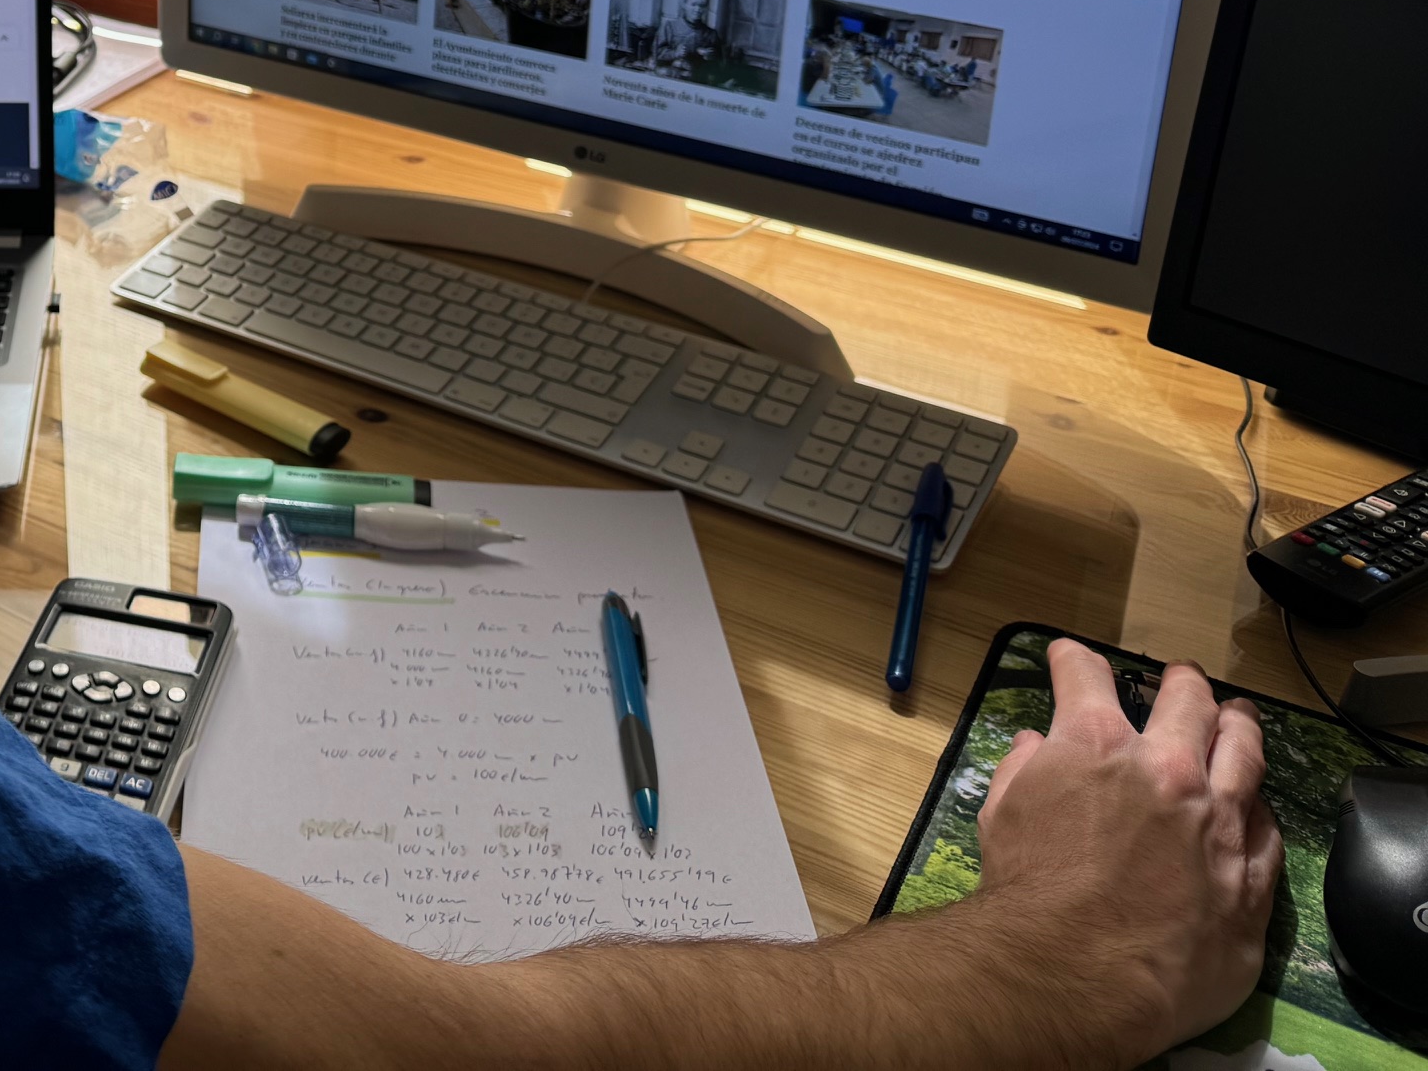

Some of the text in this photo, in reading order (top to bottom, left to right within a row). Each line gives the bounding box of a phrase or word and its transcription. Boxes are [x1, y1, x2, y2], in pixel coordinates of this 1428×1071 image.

[331, 28, 367, 44] parques
[369, 34, 412, 54] infantiles
[433, 38, 556, 72] El Ayuntamiento convoca
[432, 51, 463, 66] plazas
[464, 59, 488, 72] para
[431, 62, 488, 83] electricistas
[497, 78, 546, 97] conserjes
[602, 88, 668, 111] Marie Curie
[603, 75, 766, 119] Noventa años de la muerte de
[793, 132, 924, 169] en el curso se ajedrez
[795, 116, 980, 167] Decenas de vecinos participan
[791, 146, 898, 177] organizado por el
[88, 769, 111, 780] DEL
[125, 777, 146, 789] AC
